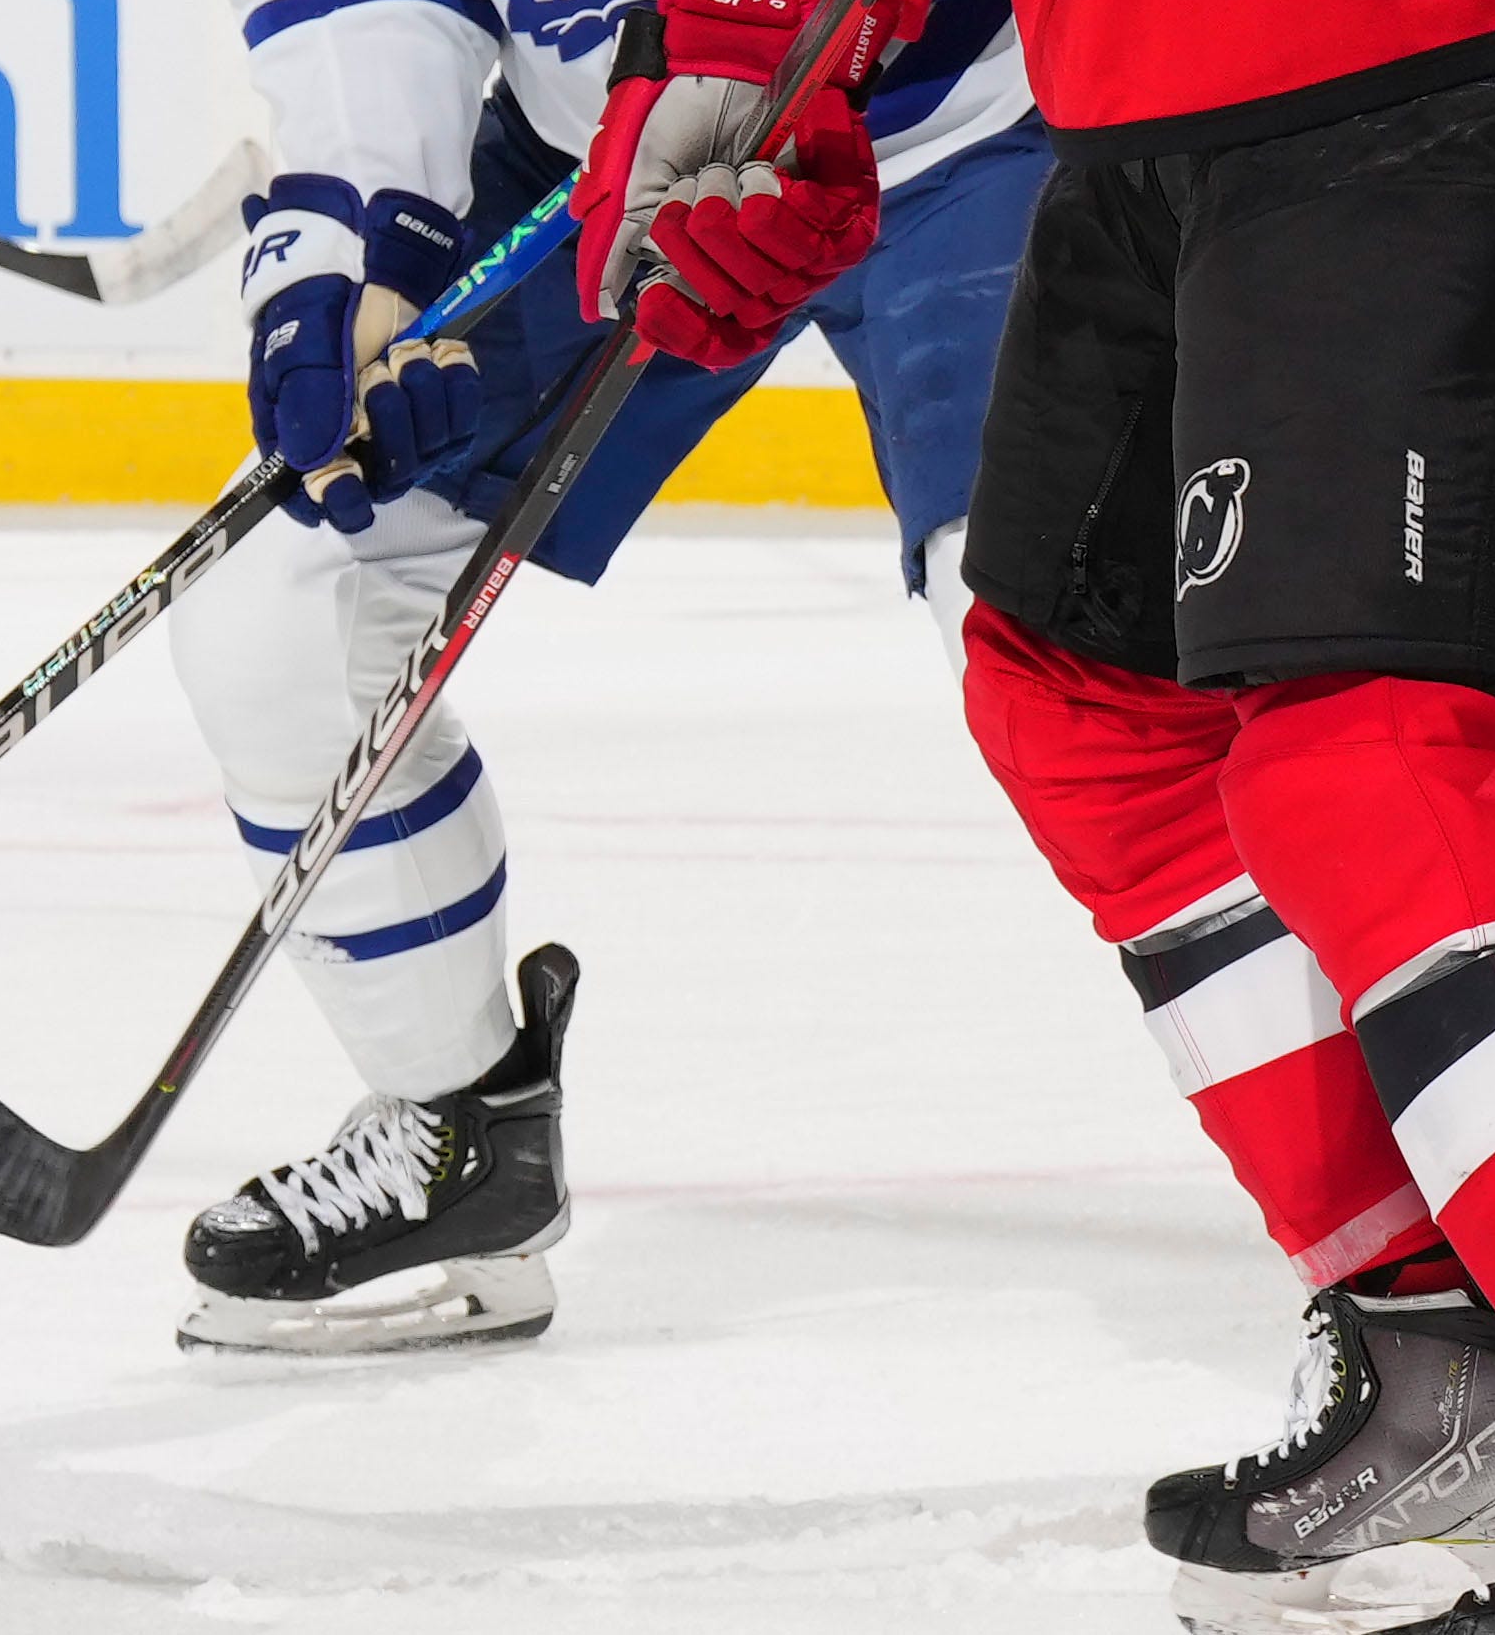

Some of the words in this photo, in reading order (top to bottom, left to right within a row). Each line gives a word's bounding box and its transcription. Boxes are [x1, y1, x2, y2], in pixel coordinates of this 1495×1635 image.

[847, 13, 878, 83] BASTIAN
[394, 211, 456, 251] BAUER
[441, 189, 570, 317] SYNC
[244, 449, 286, 488] HOLL
[1403, 448, 1431, 584] BAUER
[463, 554, 515, 631] BAUER
[1292, 1466, 1381, 1541] BAUER
